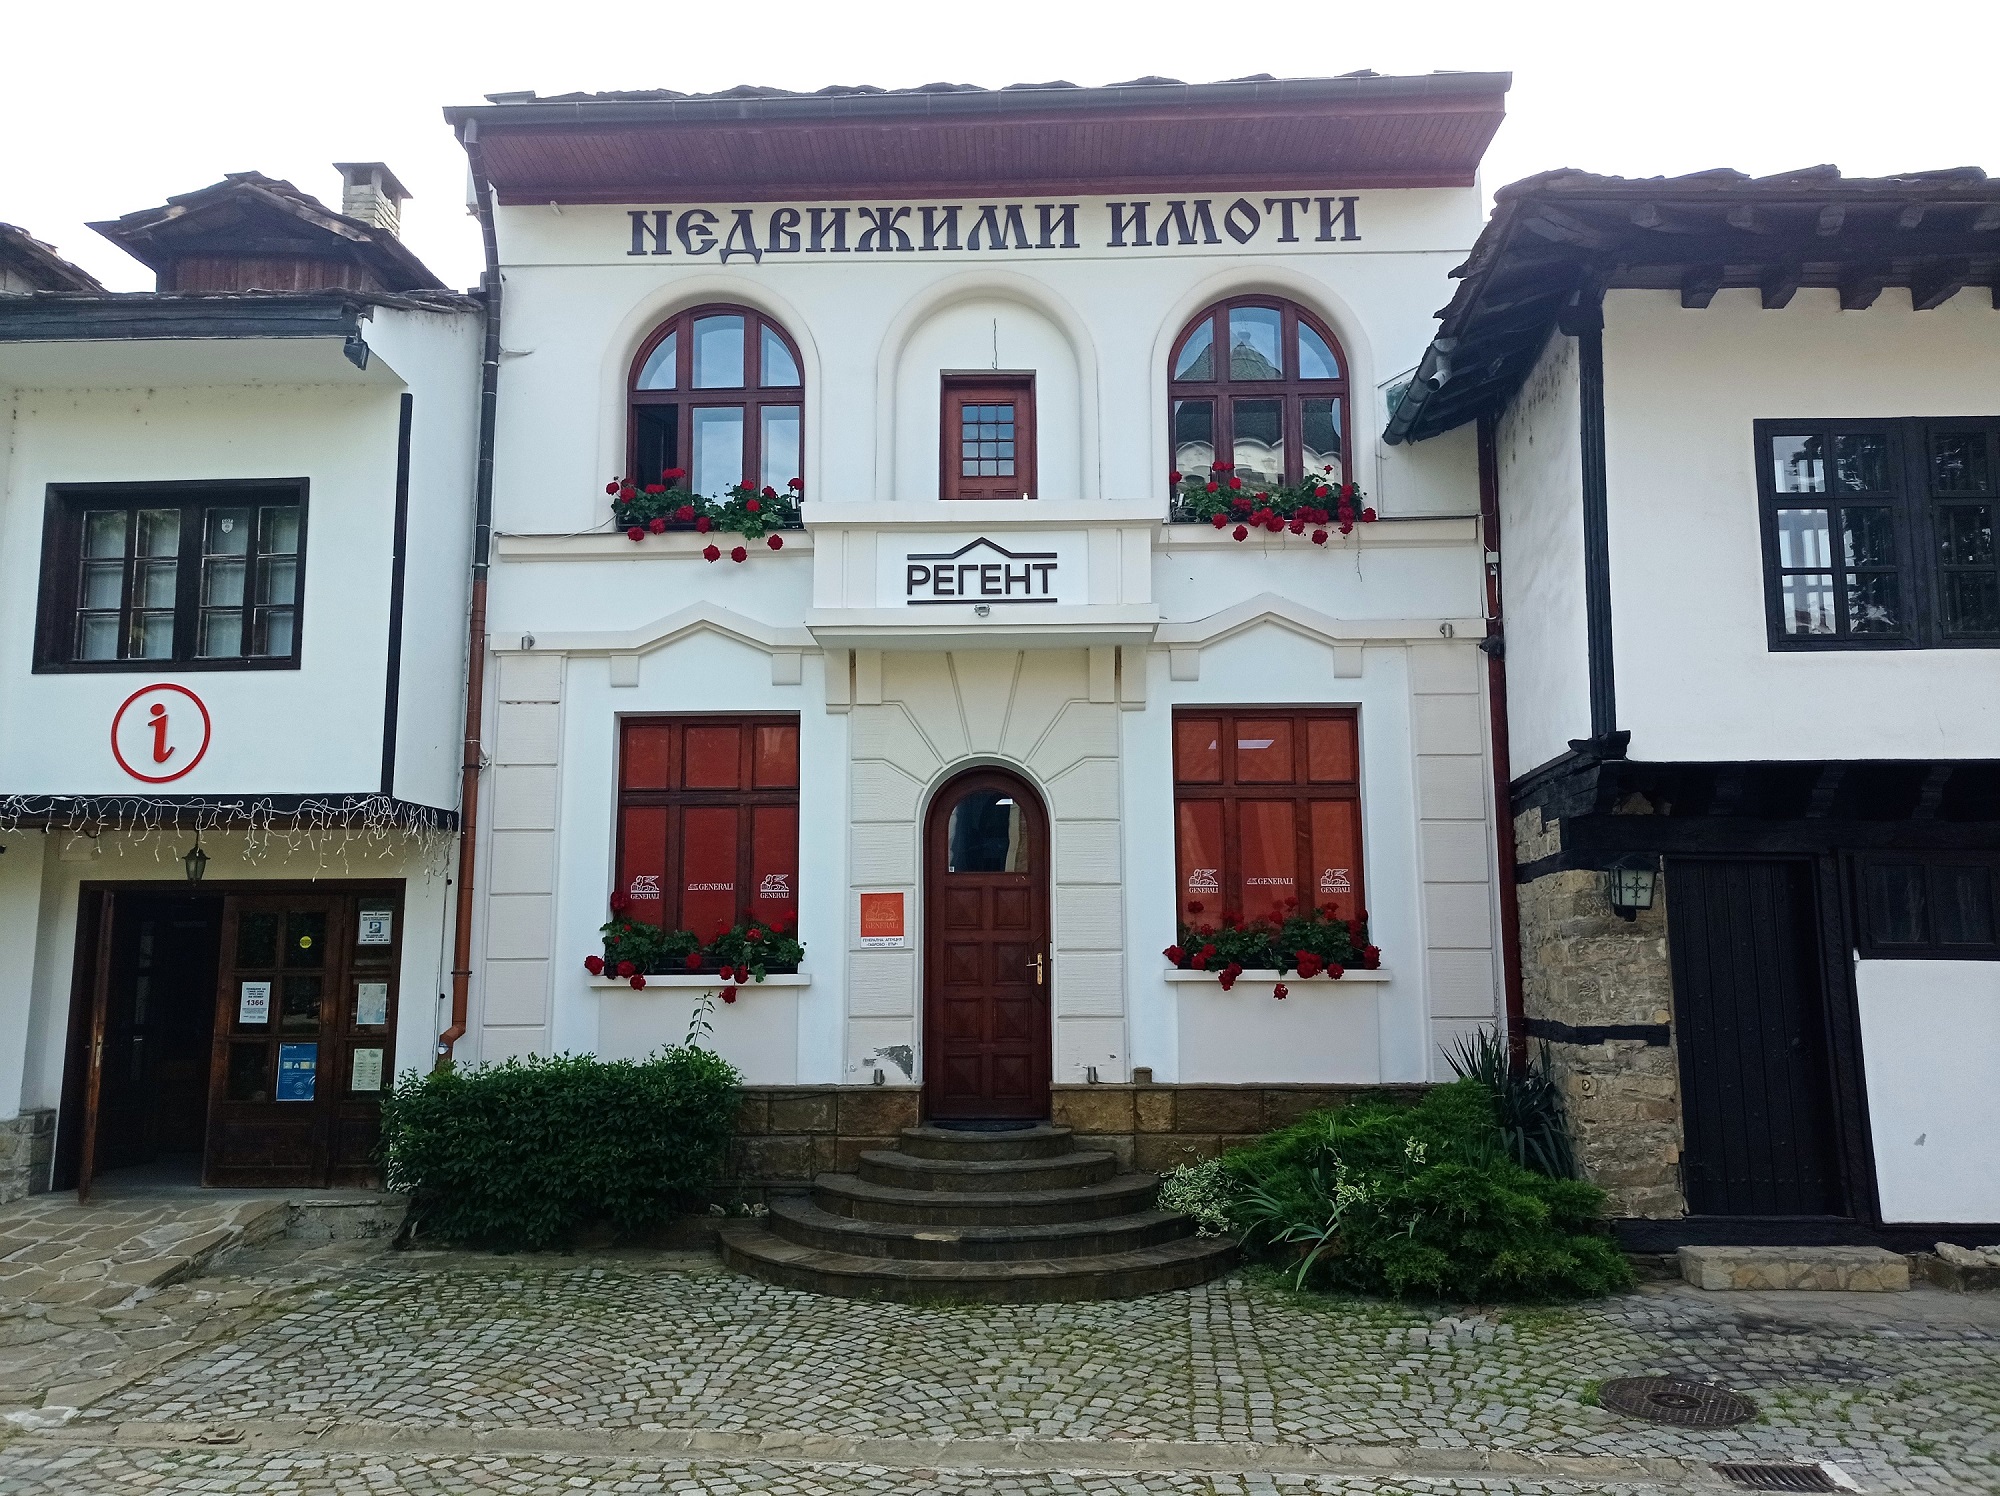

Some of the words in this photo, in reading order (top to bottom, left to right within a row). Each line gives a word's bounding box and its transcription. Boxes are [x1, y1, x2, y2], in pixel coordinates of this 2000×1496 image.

[1106, 197, 1362, 247] ИМОТИ
[907, 563, 1058, 595] РЕГЕНТ
[1257, 877, 1294, 885] GENERALI
[698, 883, 734, 891] GENERALI
[1188, 886, 1219, 894] GENERALI
[1320, 886, 1351, 894] GENERALI
[865, 921, 899, 929] GENERALI
